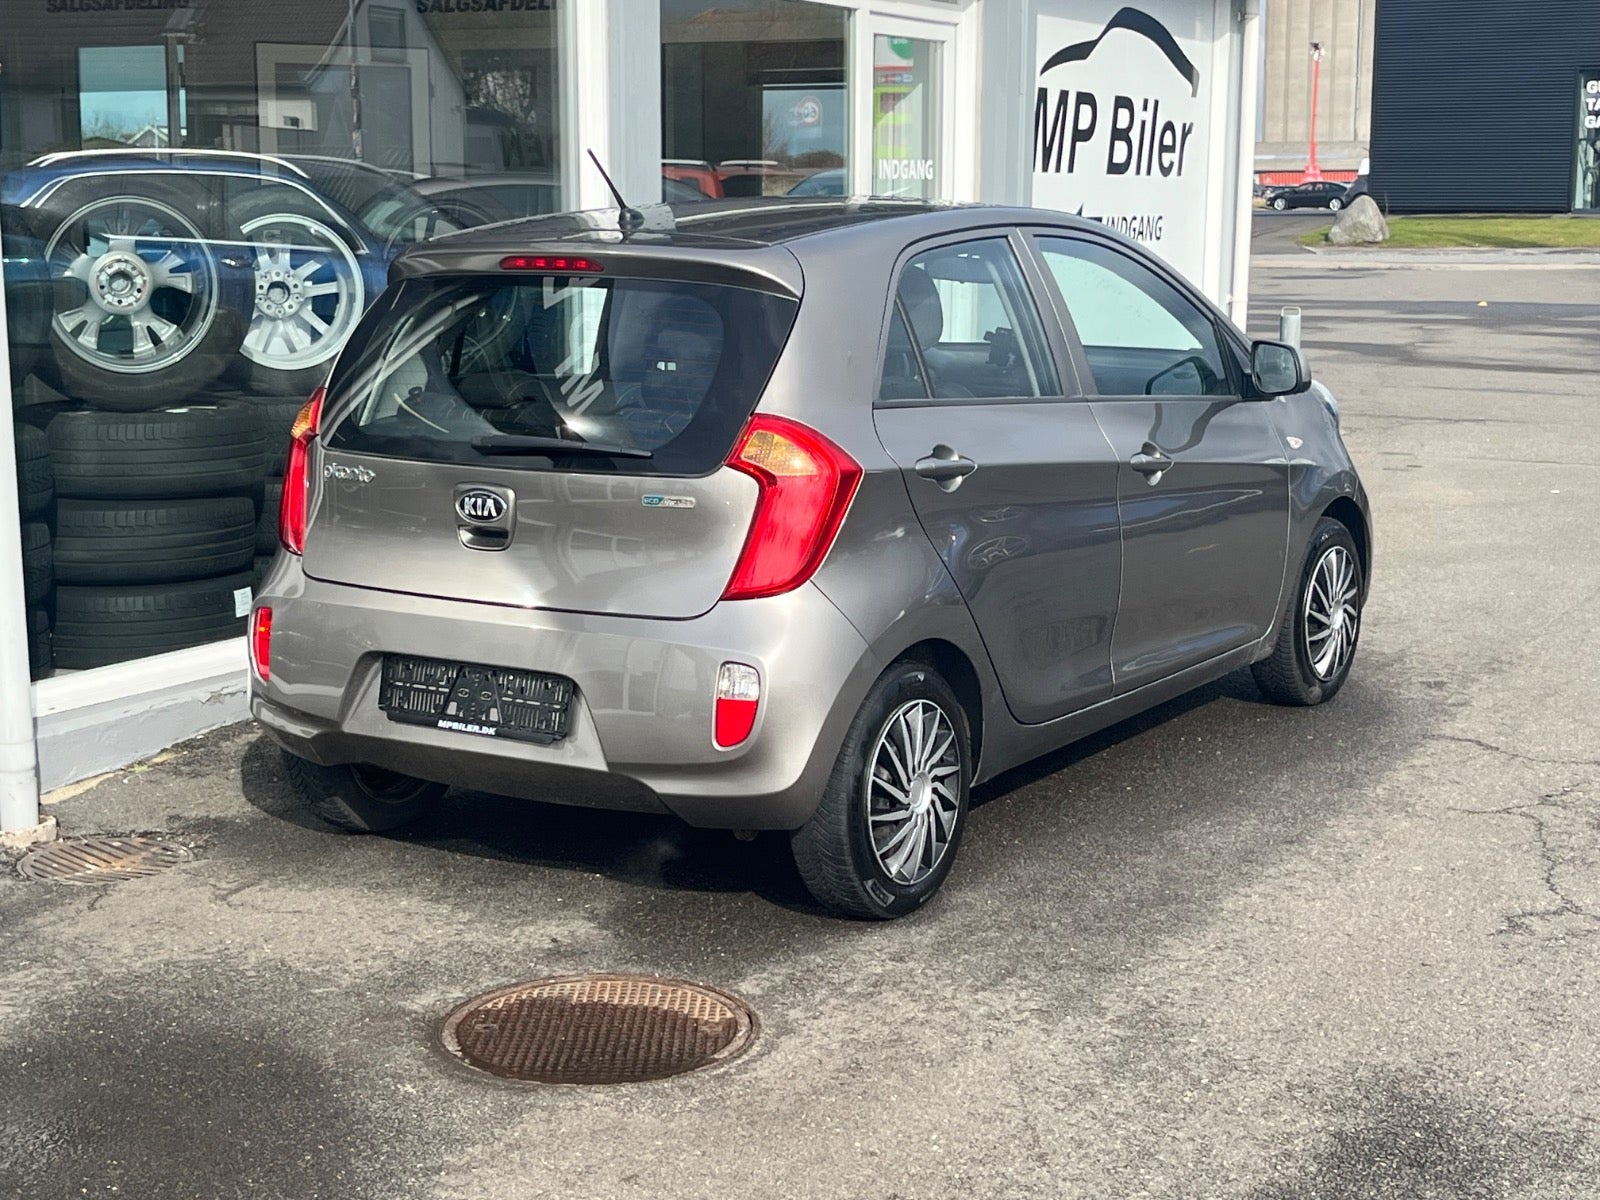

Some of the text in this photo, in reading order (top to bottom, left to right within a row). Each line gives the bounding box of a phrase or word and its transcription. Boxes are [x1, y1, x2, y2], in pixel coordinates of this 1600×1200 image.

[1586, 80, 1600, 94] G
[1032, 86, 1195, 178] MP Biler
[878, 159, 934, 181] INDGANG
[463, 496, 498, 518] KIA
[437, 718, 497, 736] MPBILER.DK
